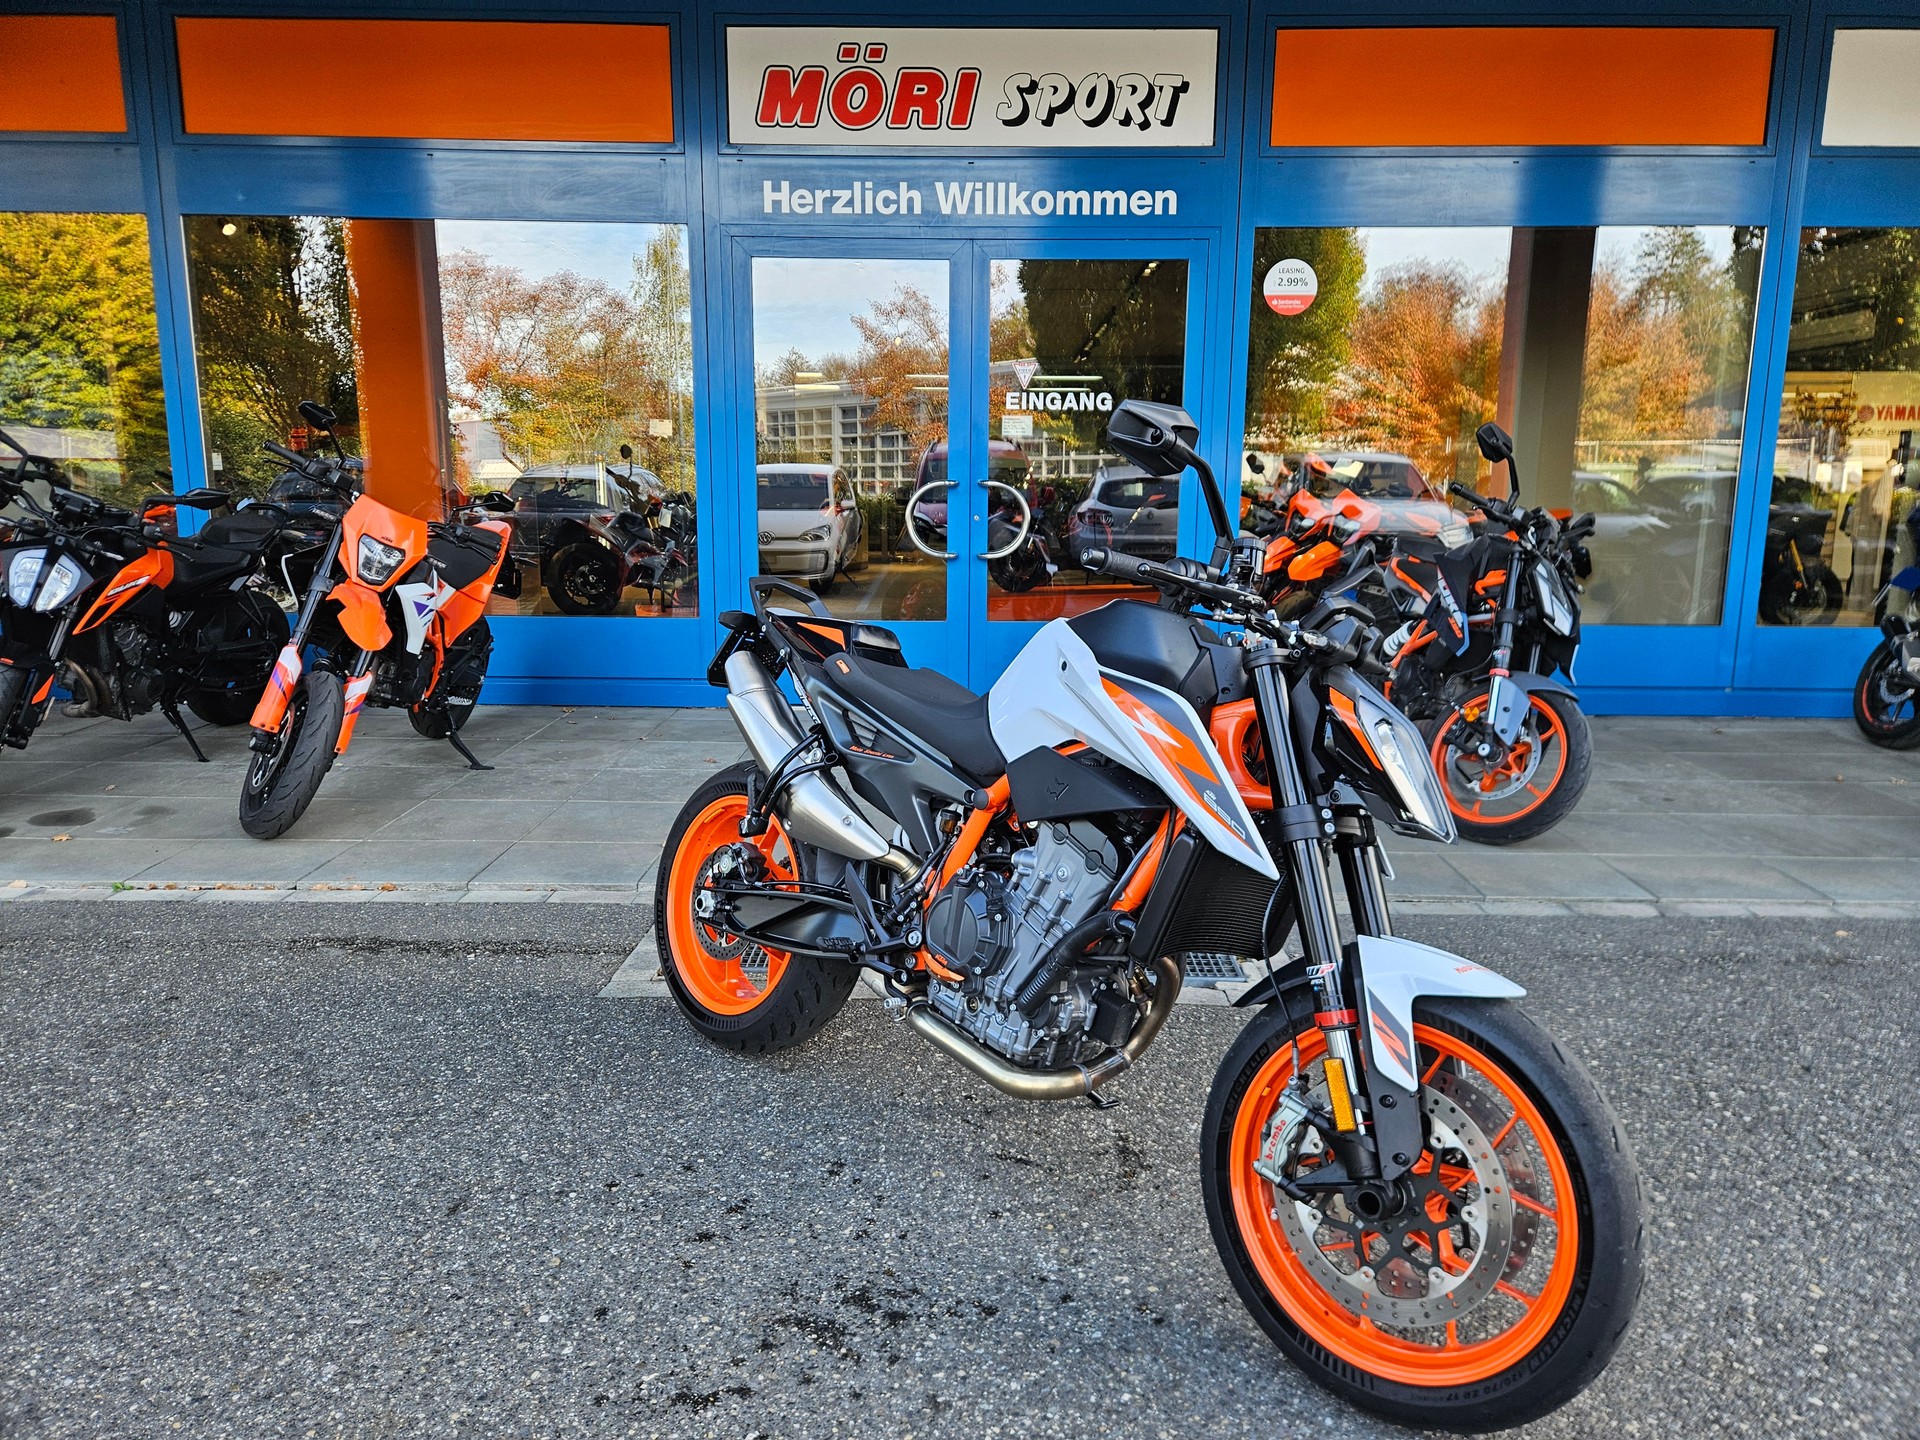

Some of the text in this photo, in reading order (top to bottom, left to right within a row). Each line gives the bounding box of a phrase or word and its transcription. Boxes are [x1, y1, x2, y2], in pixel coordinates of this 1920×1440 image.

[755, 42, 1190, 131] MÖRI SPORT
[763, 181, 1178, 216] Herzlich Willkommen
[1277, 277, 1309, 287] 2.99%
[1005, 391, 1113, 411] EINGANG
[1877, 404, 1920, 421] YAMA
[1203, 792, 1246, 840] 890
[1226, 1044, 1270, 1112] MICHELIN
[1264, 1119, 1287, 1160] brembo
